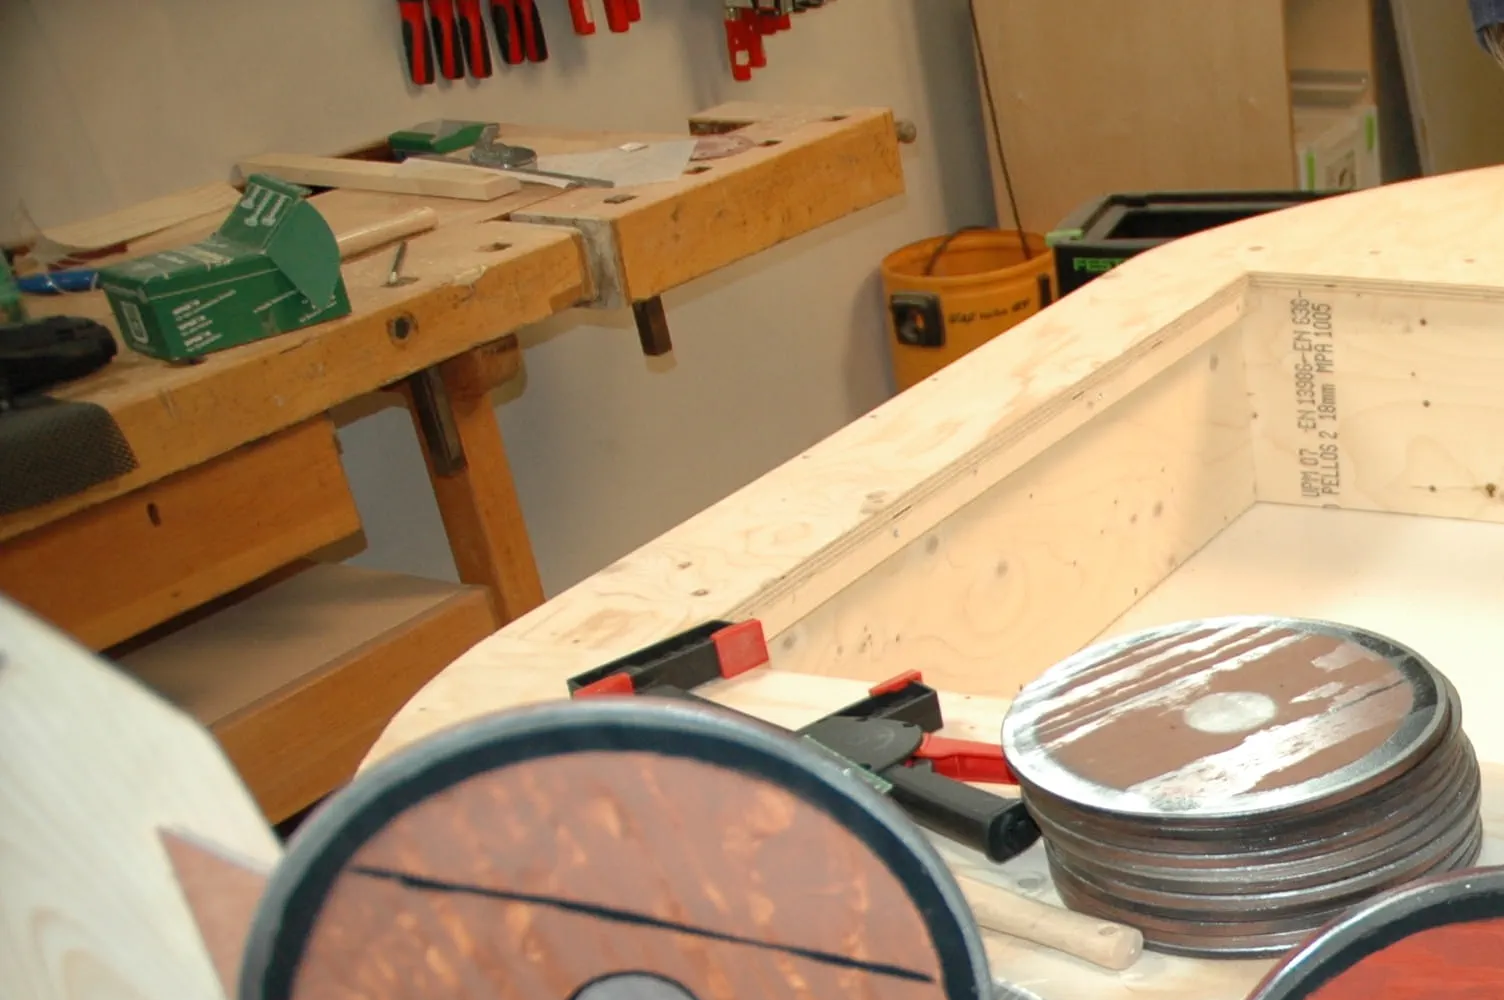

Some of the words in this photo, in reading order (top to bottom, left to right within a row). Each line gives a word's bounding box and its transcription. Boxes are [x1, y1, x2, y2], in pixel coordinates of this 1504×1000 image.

[1310, 303, 1333, 338] 1005
[1313, 343, 1334, 373] MPA
[1317, 383, 1337, 421] 18mm
[1318, 430, 1338, 440] 2
[1299, 447, 1319, 466] 07
[1319, 444, 1340, 495] PELLOS
[1300, 470, 1320, 497] UPM
